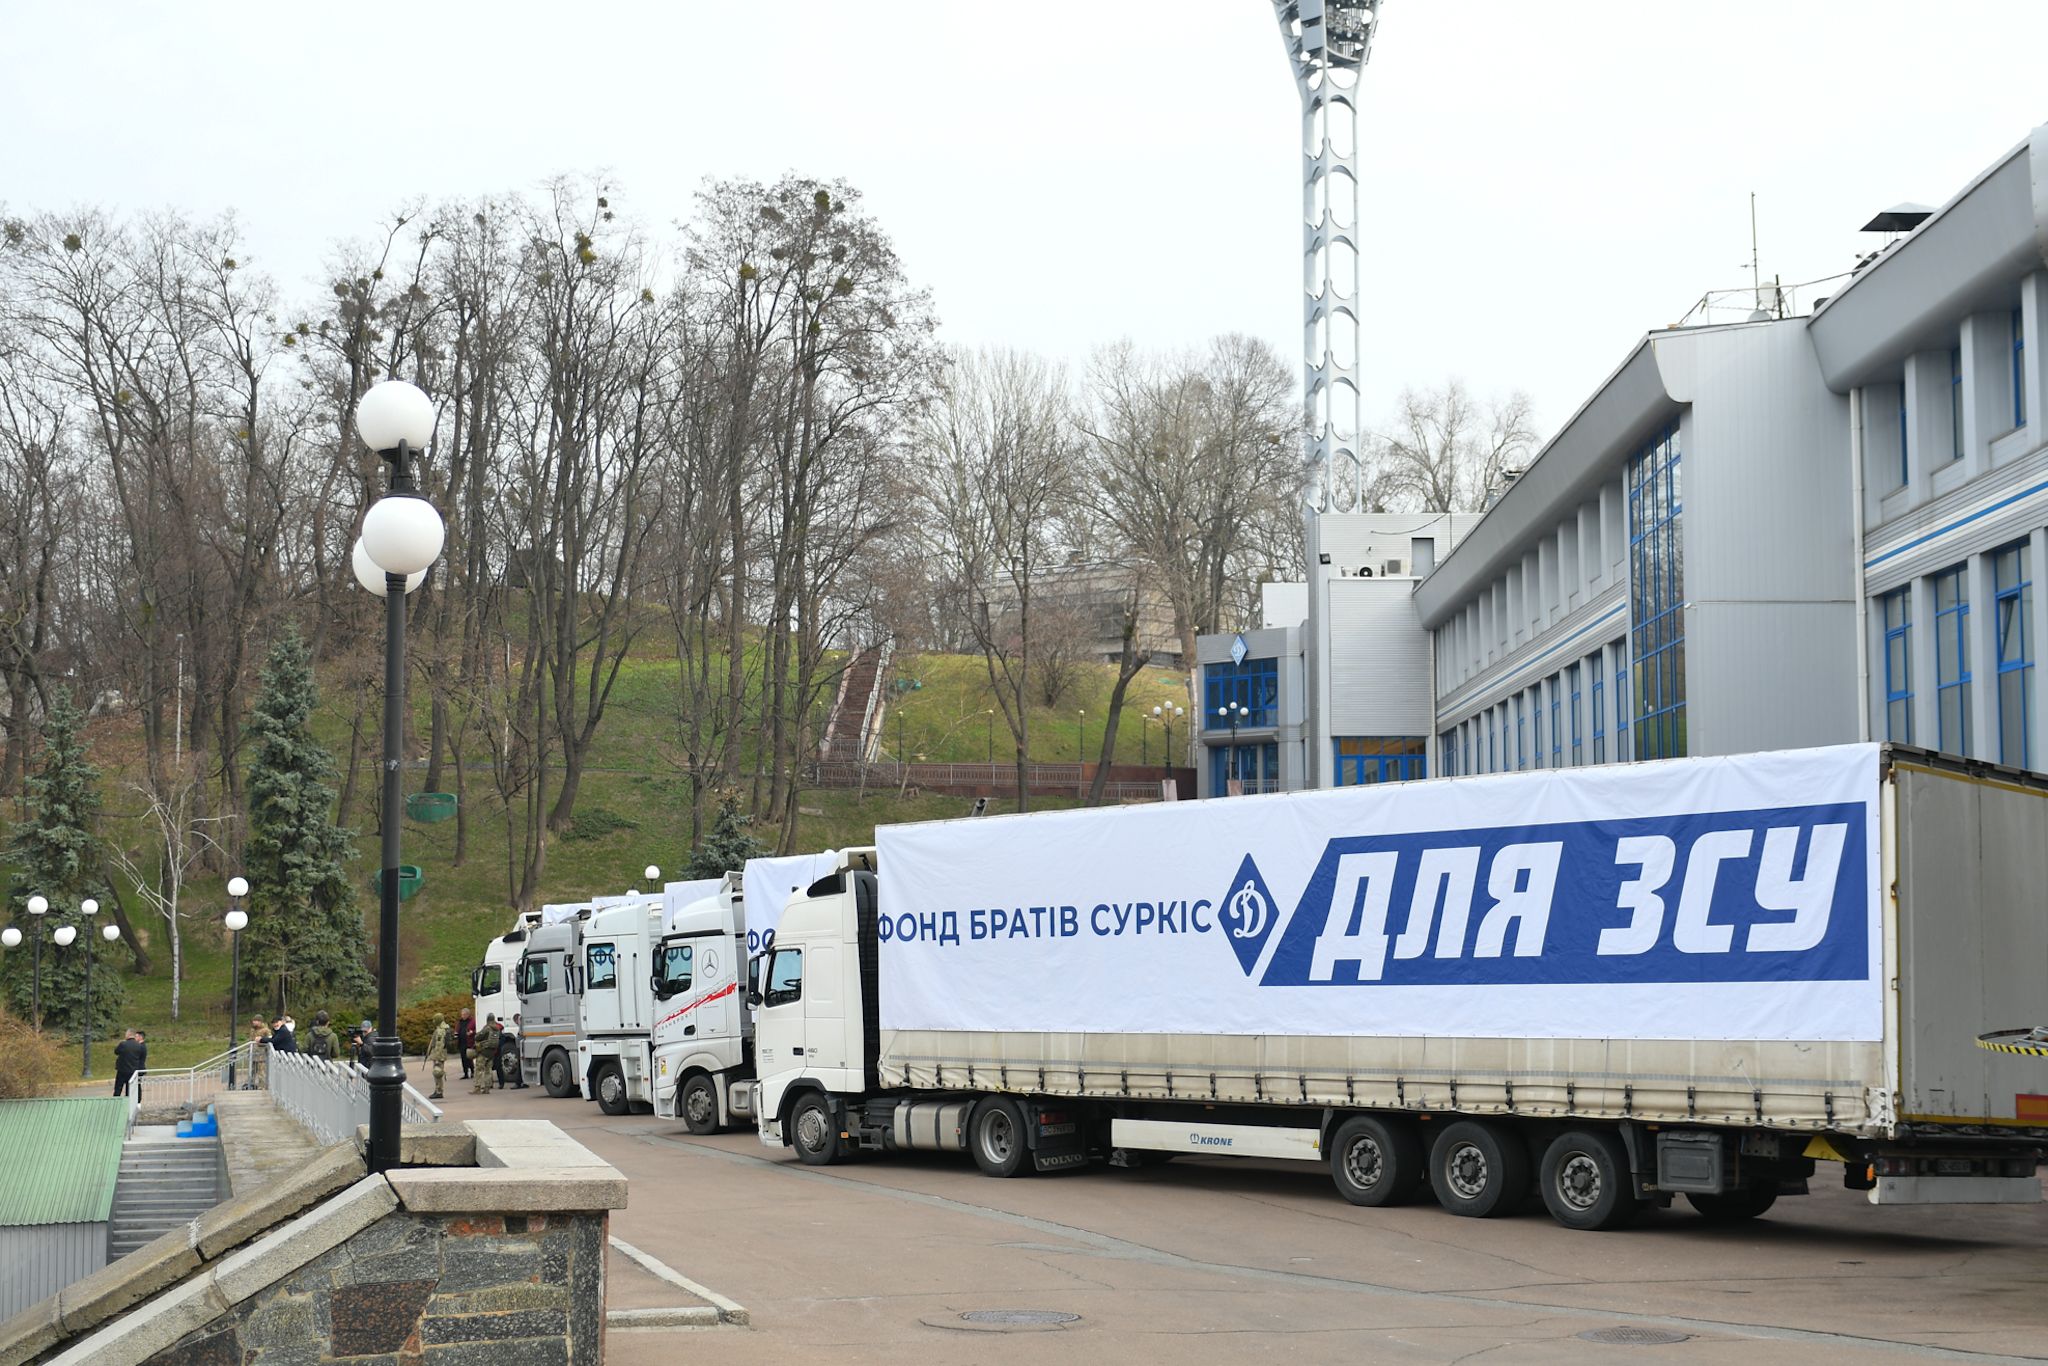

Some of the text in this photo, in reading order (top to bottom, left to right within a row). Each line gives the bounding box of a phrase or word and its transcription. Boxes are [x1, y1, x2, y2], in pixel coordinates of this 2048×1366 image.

[1308, 823, 1848, 981] ДЛЯ ЗСУ
[878, 899, 1212, 946] ФОНД БРАТІВ СУРКІС
[1200, 1136, 1233, 1146] KRONE
[1040, 1154, 1082, 1167] VOLVO
